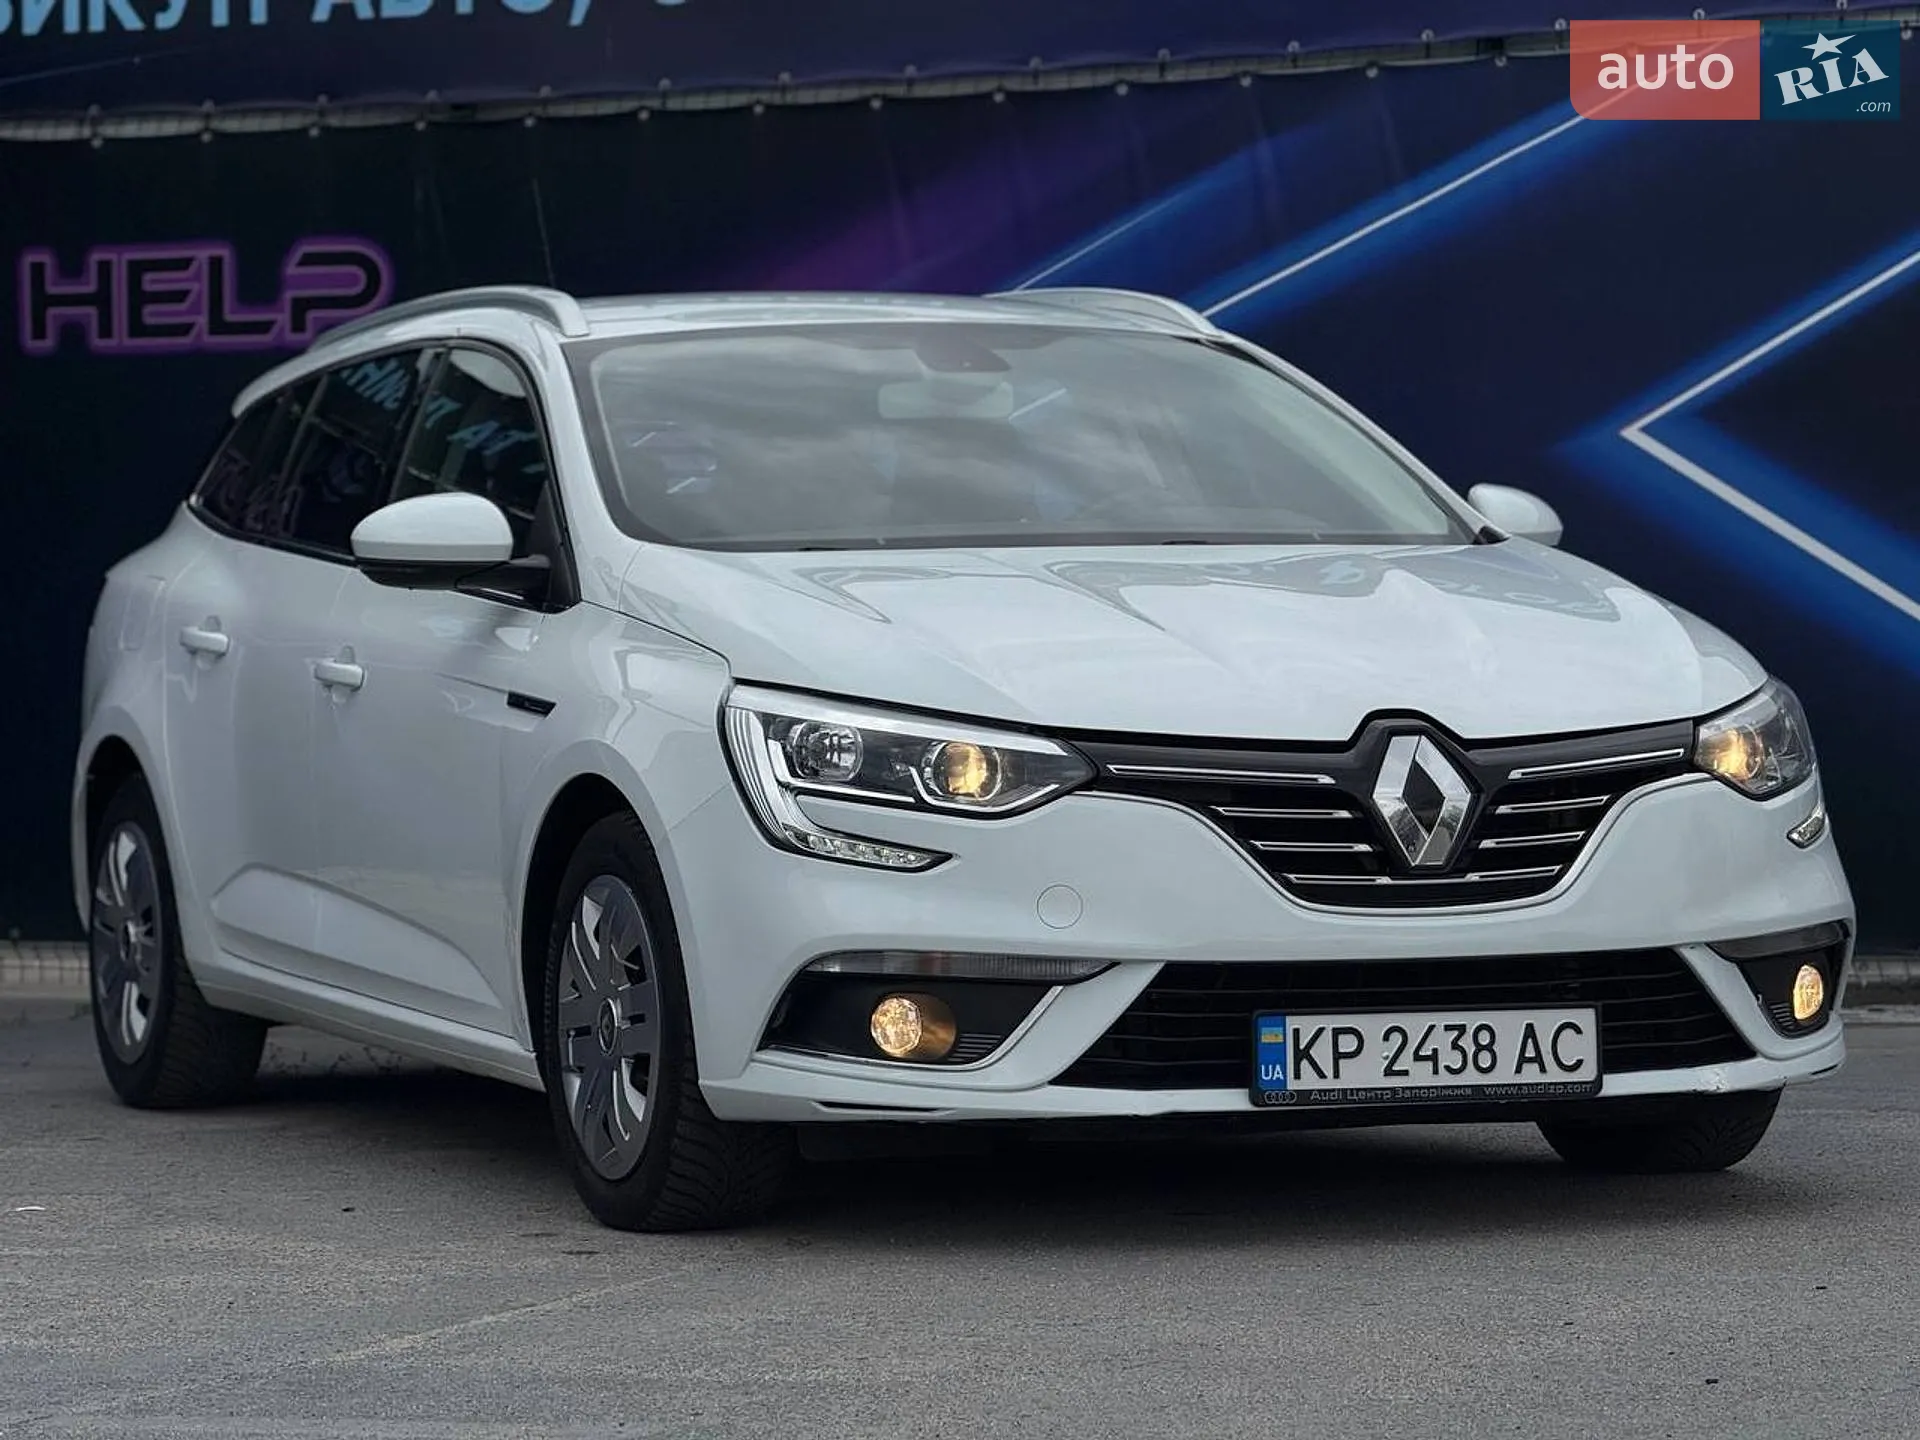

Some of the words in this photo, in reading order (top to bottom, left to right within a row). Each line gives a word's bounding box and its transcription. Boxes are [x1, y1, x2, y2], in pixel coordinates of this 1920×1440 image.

[25, 245, 386, 348] HELP
[1381, 1024, 1498, 1077] 2438
[1261, 1064, 1285, 1081] UA
[1310, 1089, 1343, 1101] Audi
